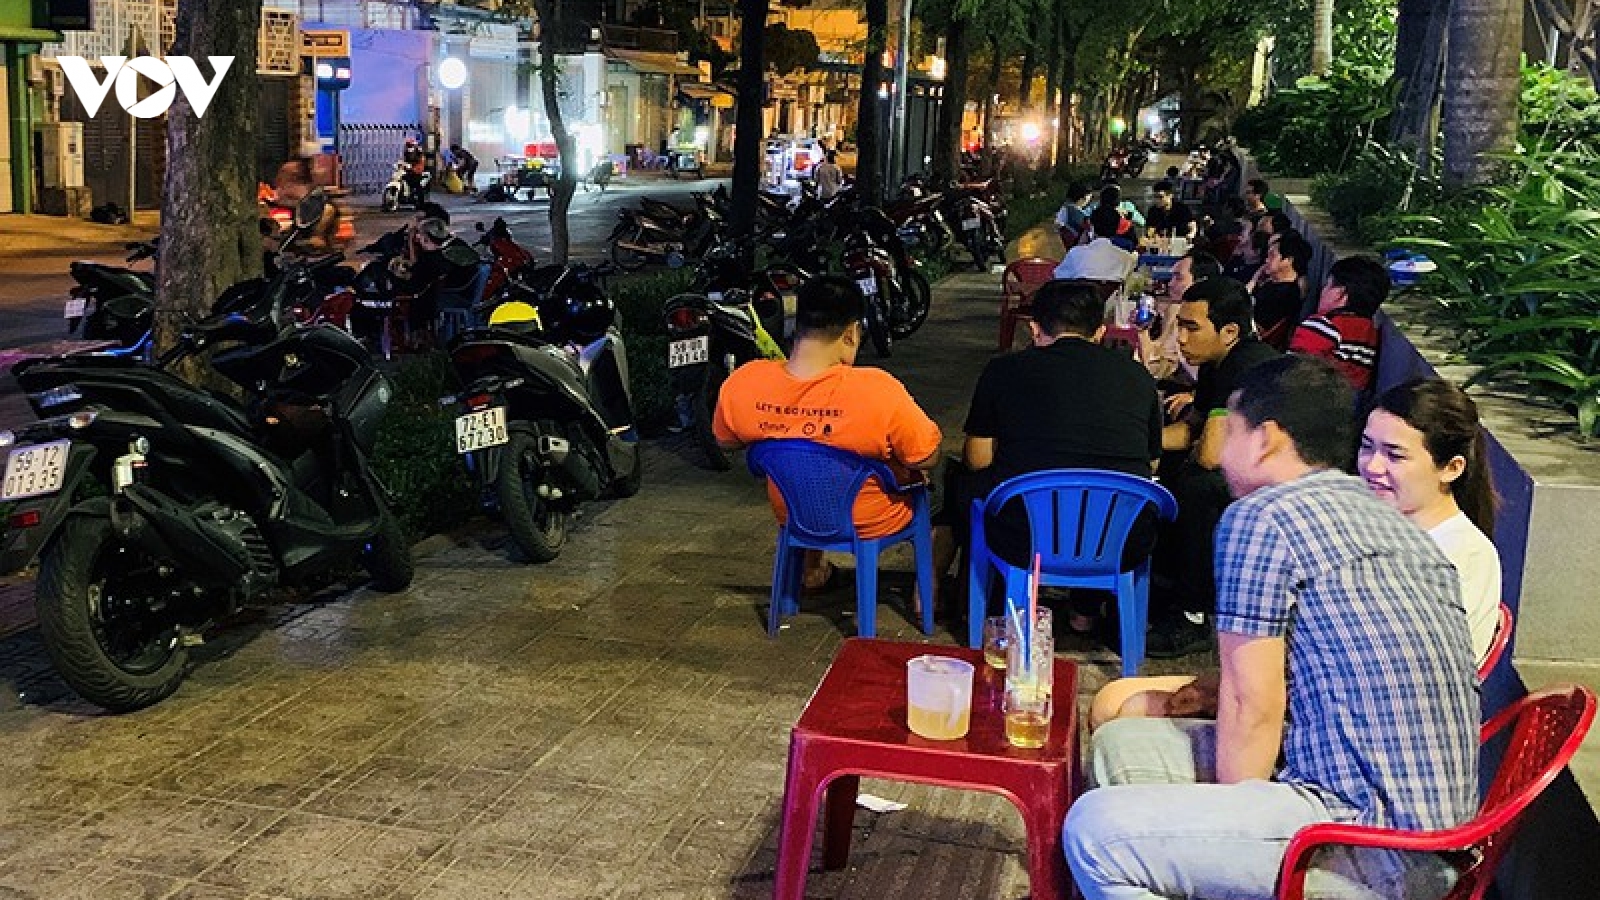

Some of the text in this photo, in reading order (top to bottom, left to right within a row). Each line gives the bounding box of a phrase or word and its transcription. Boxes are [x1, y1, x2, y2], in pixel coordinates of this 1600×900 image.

[784, 405, 799, 415] GO
[463, 411, 497, 433] 72-E1
[16, 445, 60, 473] 59-T2
